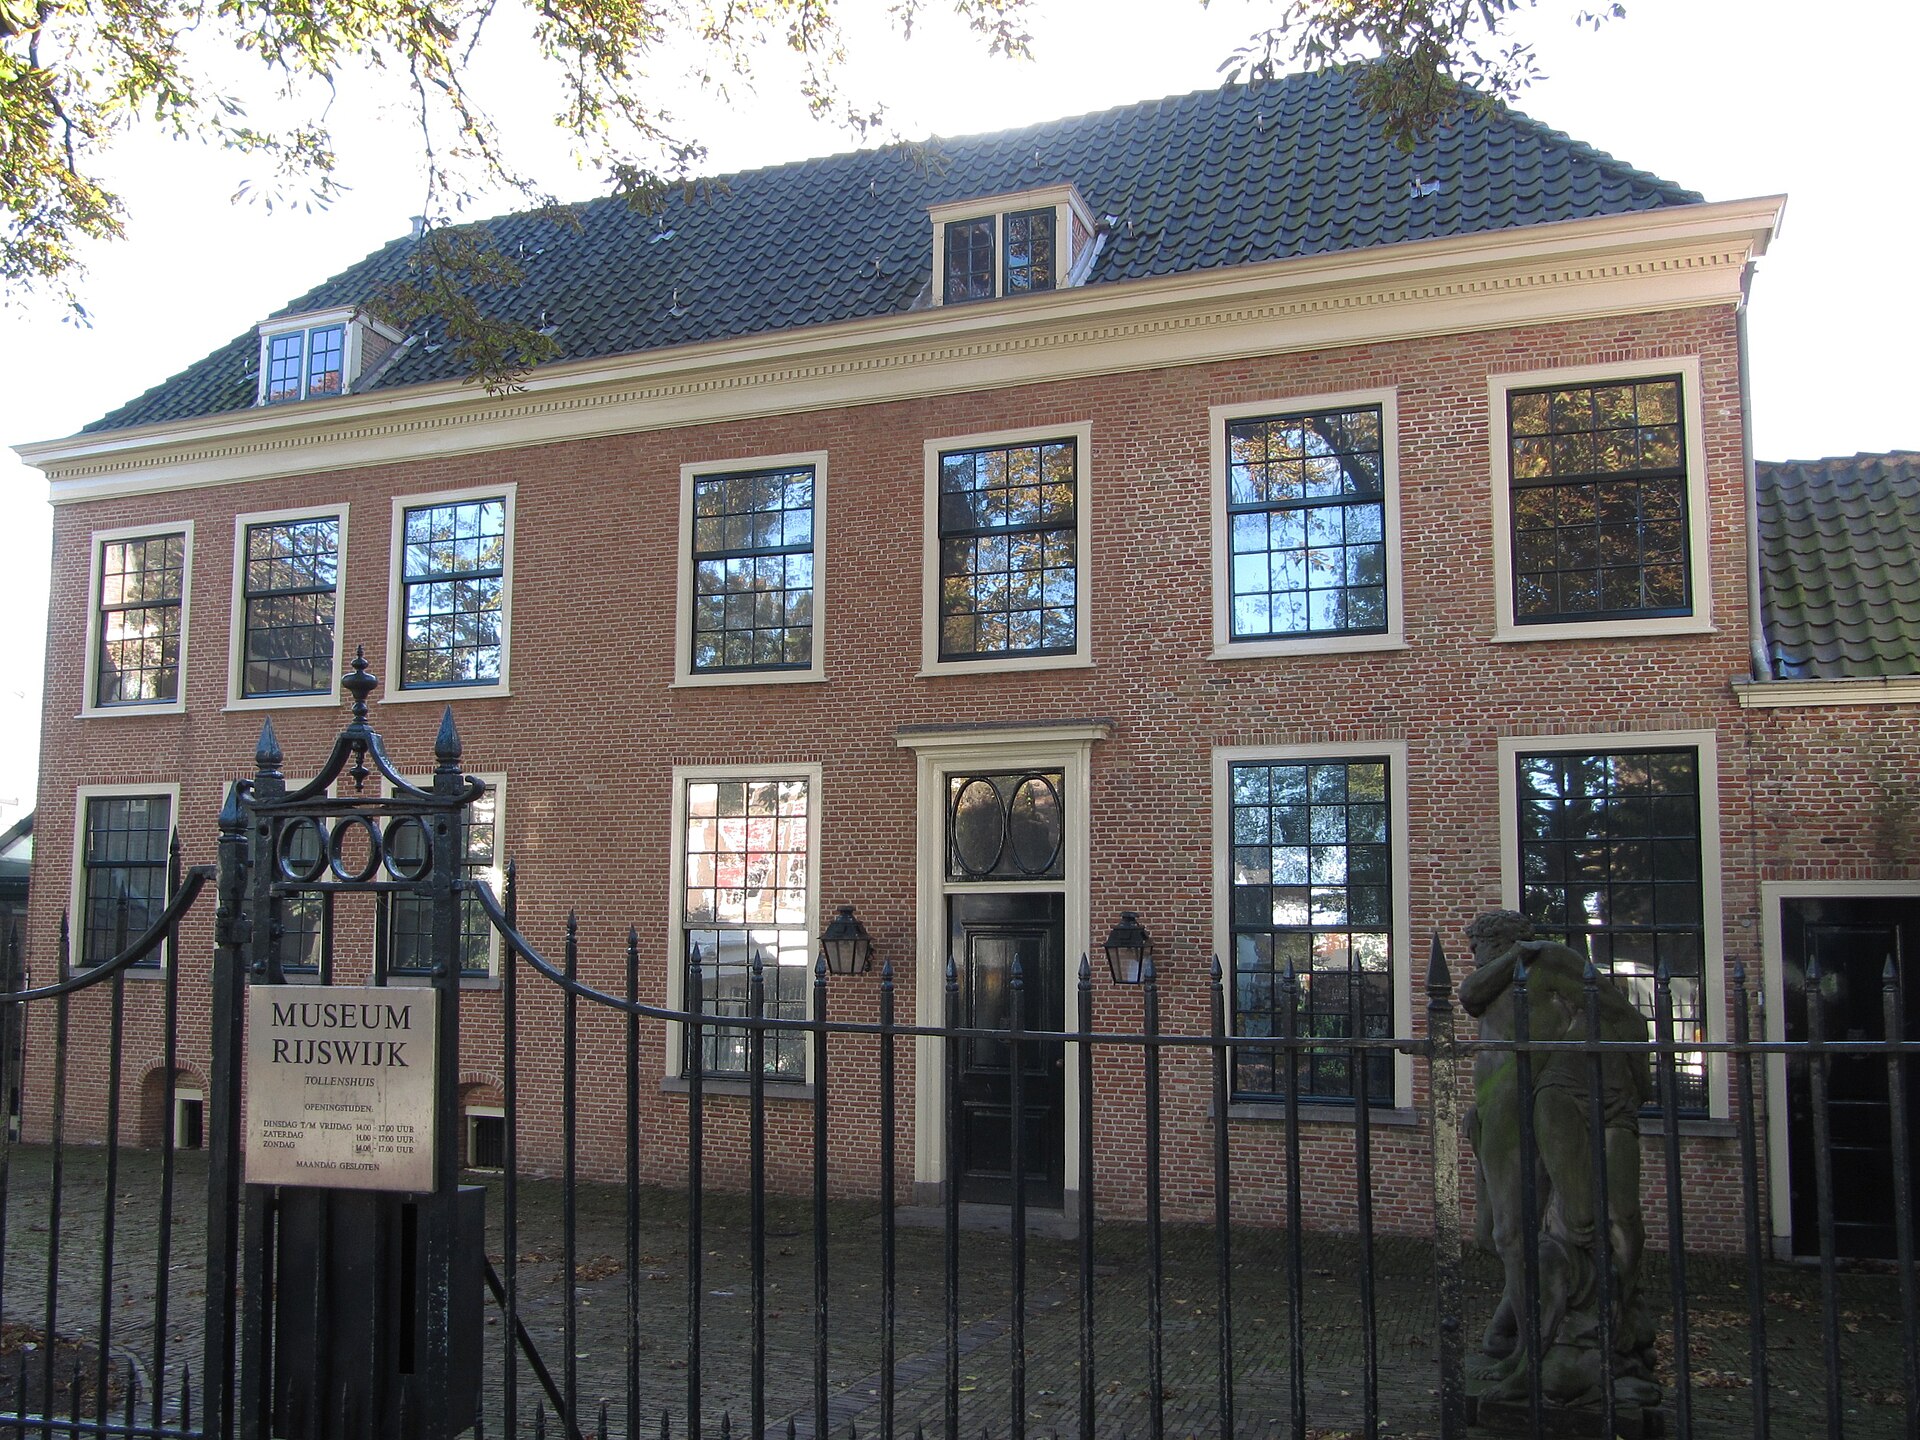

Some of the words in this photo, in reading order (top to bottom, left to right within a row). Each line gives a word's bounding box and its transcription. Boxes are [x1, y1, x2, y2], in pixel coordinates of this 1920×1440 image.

[271, 1002, 412, 1030] MUSEUM
[271, 1038, 410, 1067] RIJSWIJK
[305, 1076, 375, 1087] TOLLENSHUIS
[263, 1120, 298, 1128] DINSDAG
[301, 1121, 316, 1129] T/M
[319, 1122, 352, 1131] VRIJDAG
[356, 1123, 372, 1132] 14.00
[378, 1125, 395, 1133] 17.00
[396, 1125, 415, 1133] UUR
[263, 1130, 304, 1139] ZATERDAG
[378, 1135, 395, 1143] 17.00
[396, 1135, 415, 1144] UUR
[263, 1140, 296, 1149] ZONDAG
[378, 1145, 394, 1153] 17.00
[396, 1146, 415, 1154] UUR
[296, 1161, 337, 1169] MAANDAG
[339, 1162, 380, 1171] GESLOTEN
